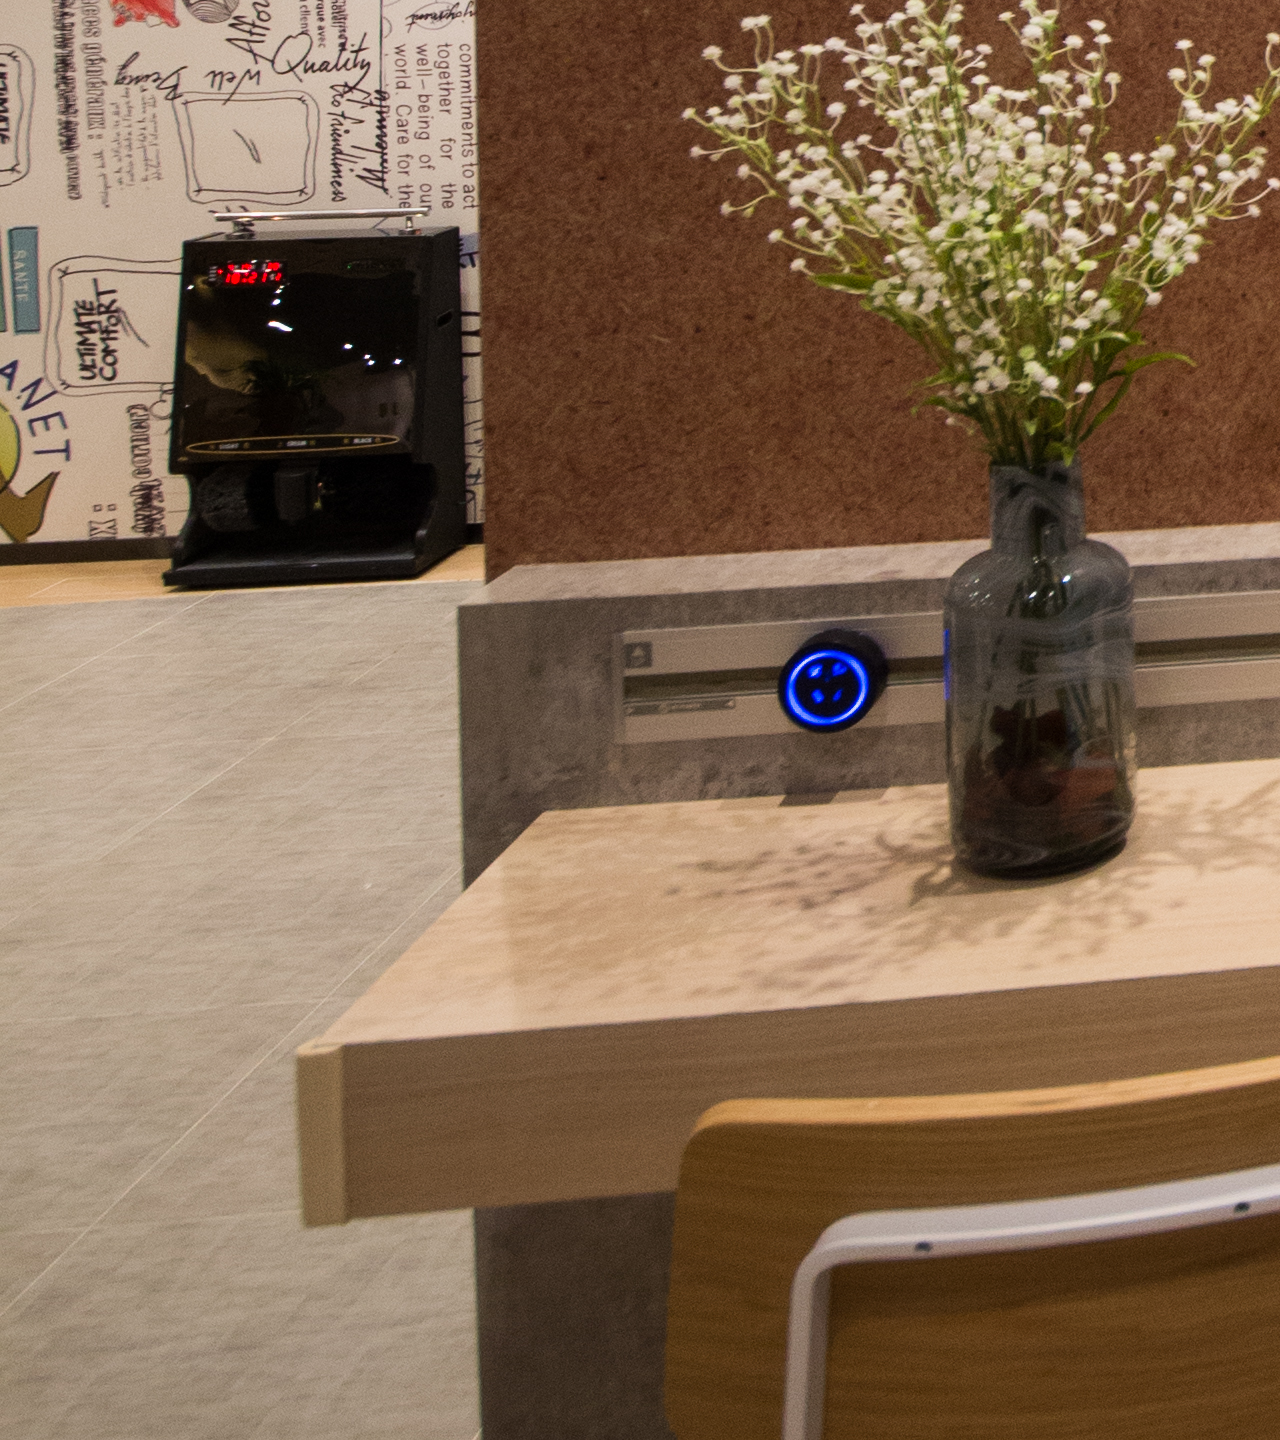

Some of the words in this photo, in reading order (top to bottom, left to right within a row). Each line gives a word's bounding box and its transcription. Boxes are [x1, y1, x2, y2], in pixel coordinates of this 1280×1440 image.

[114, 51, 188, 101] Being
[271, 32, 371, 95] Quality
[393, 43, 412, 95] world.
[434, 42, 455, 115] together
[203, 69, 261, 105] Well
[458, 42, 477, 158] commitments
[395, 104, 413, 145] Care
[396, 153, 414, 176] for
[418, 153, 436, 171] of
[439, 137, 457, 160] for
[460, 162, 477, 179] to
[397, 183, 414, 209] the
[440, 182, 457, 210] the
[461, 183, 477, 210] act
[73, 299, 97, 381] ULTIMATE
